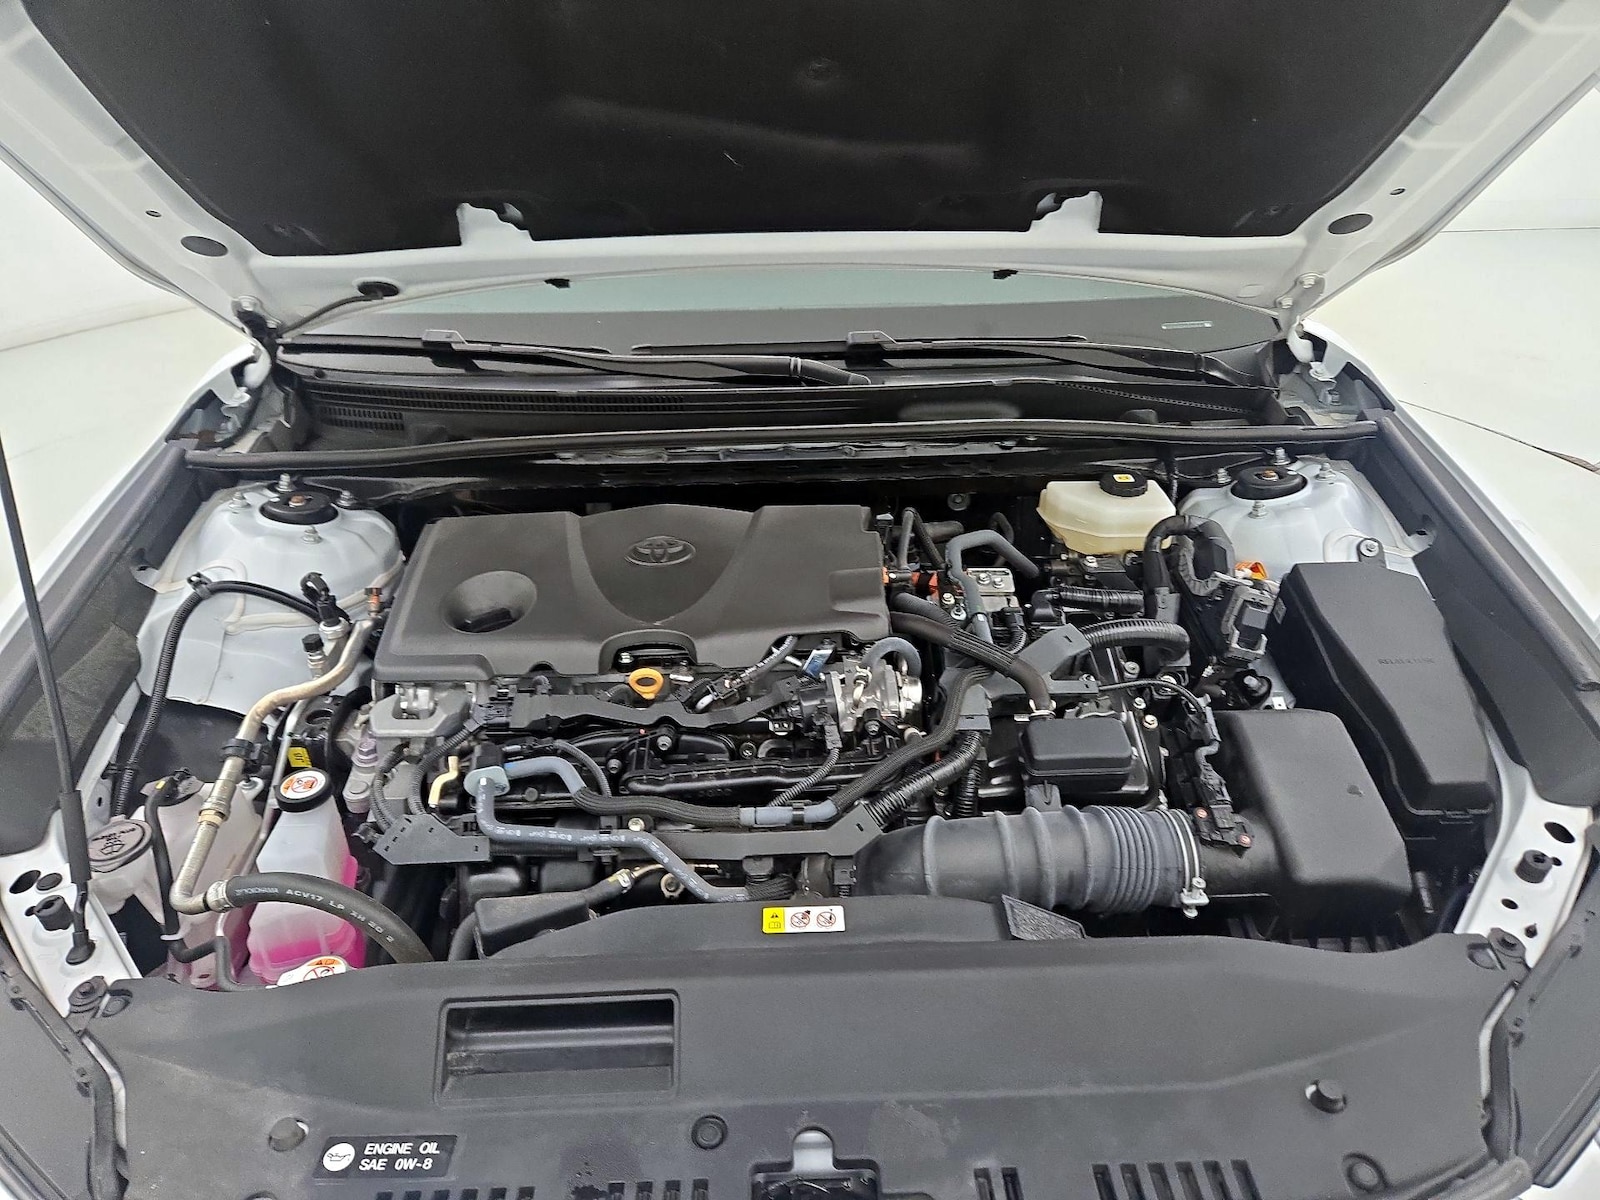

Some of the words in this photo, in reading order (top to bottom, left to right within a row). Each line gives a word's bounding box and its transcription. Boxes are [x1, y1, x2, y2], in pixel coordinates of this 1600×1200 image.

[285, 889, 324, 902] ACV17
[329, 900, 345, 911] LP
[364, 1142, 413, 1155] ENGINE
[419, 1141, 440, 1154] OIL
[358, 1158, 388, 1171] SAE
[394, 1157, 433, 1170] 0W-8
